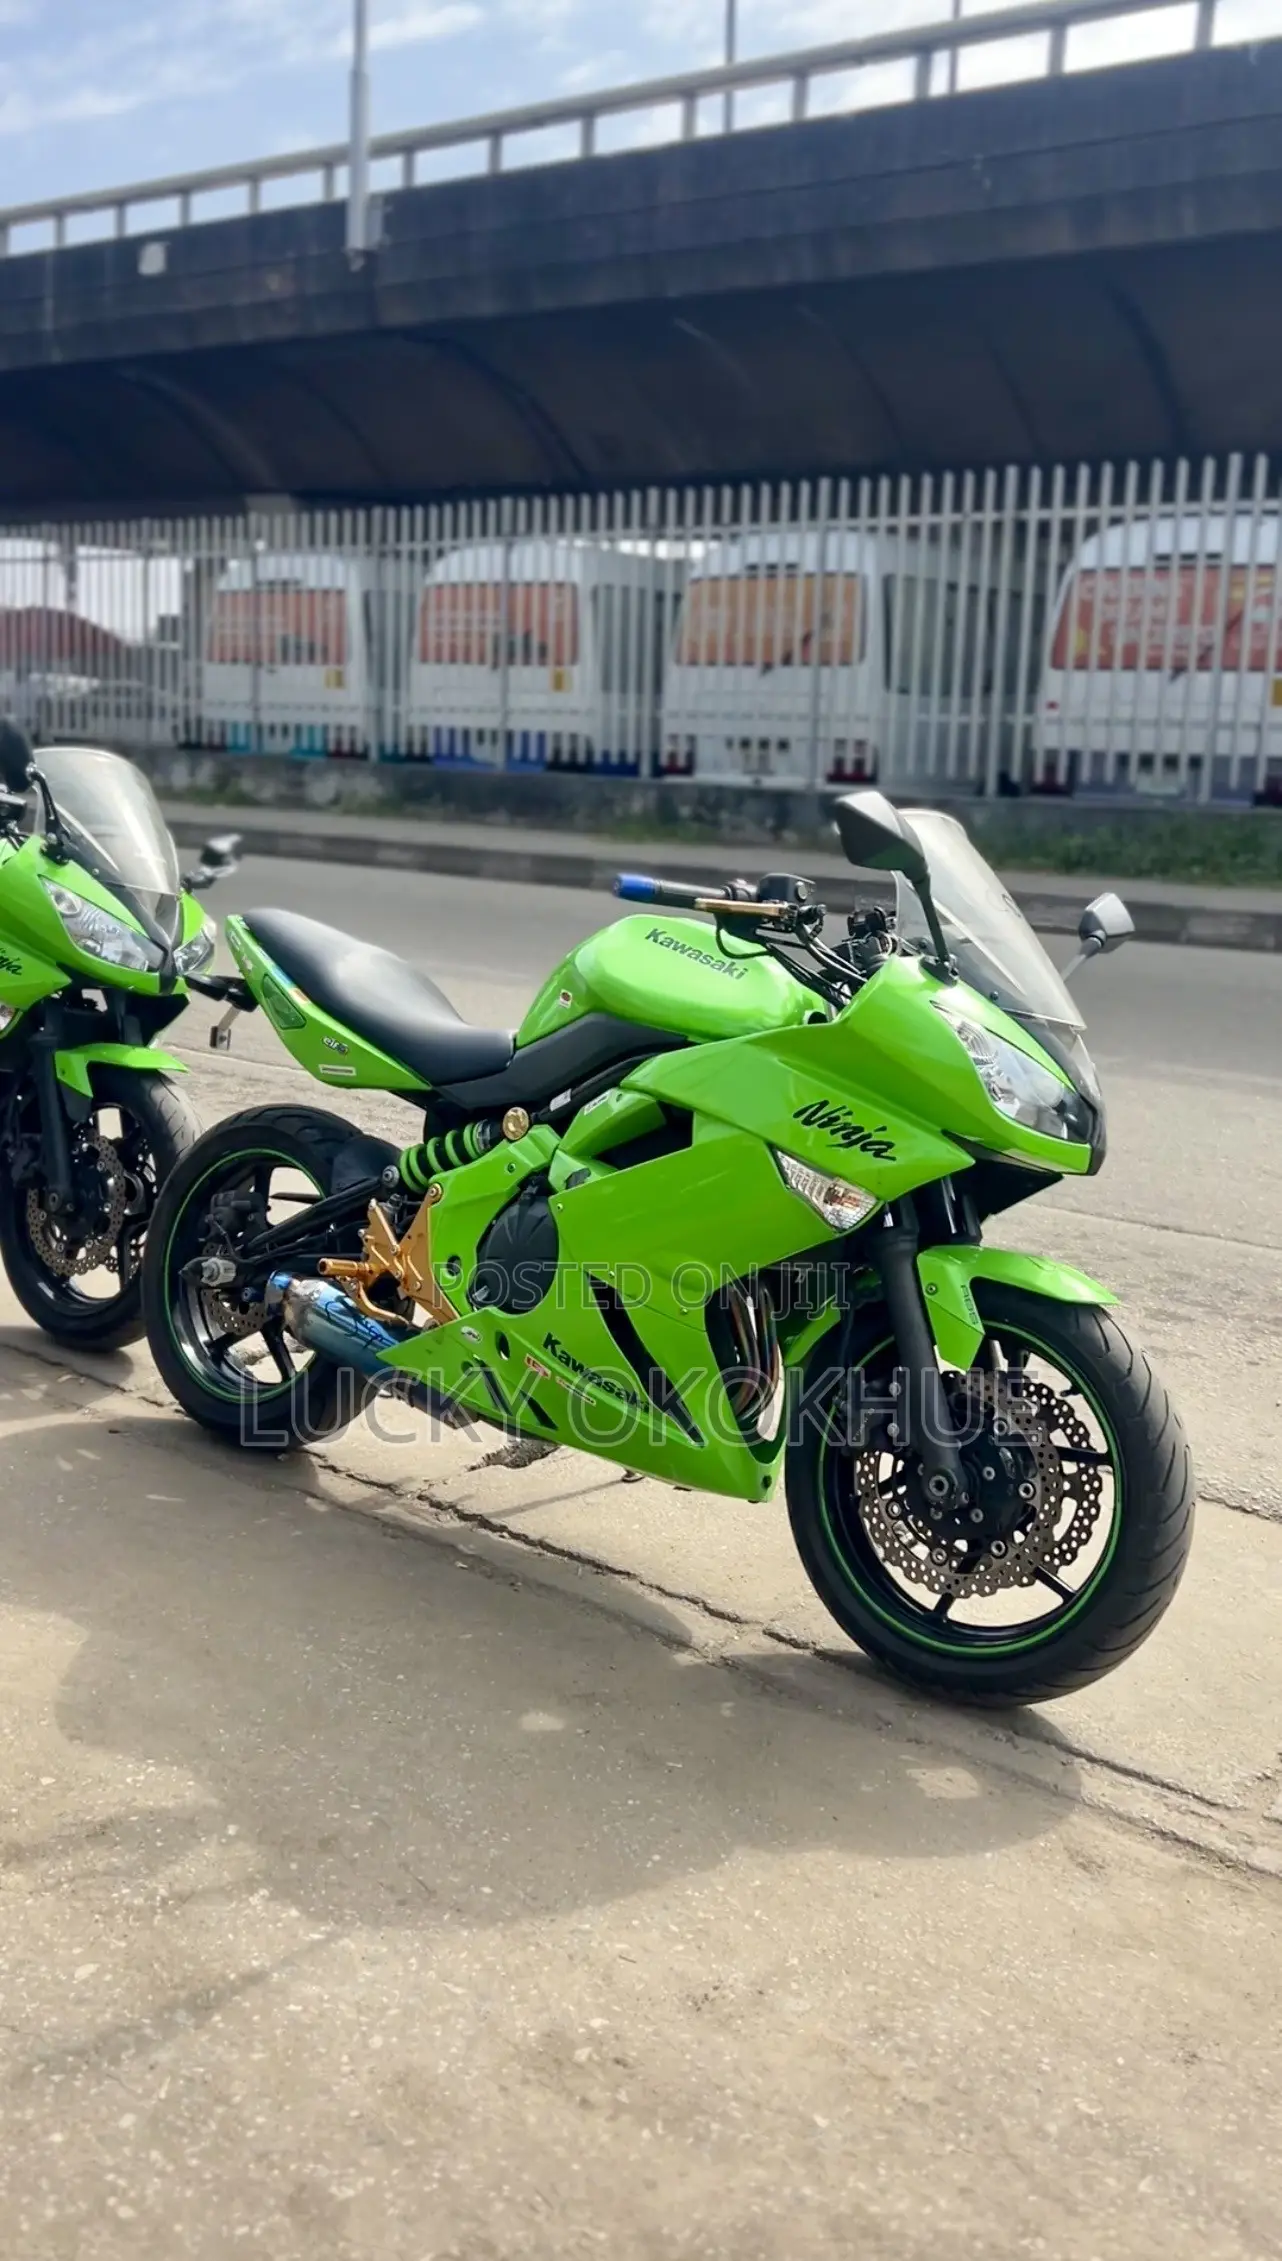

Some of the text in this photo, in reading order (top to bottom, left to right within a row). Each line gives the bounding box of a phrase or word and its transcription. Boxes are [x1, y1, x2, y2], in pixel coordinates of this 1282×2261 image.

[645, 928, 748, 981] Kawasaki
[793, 1100, 896, 1162] Ninja
[960, 1284, 979, 1325] ABS
[543, 1332, 650, 1414] Kawasaki
